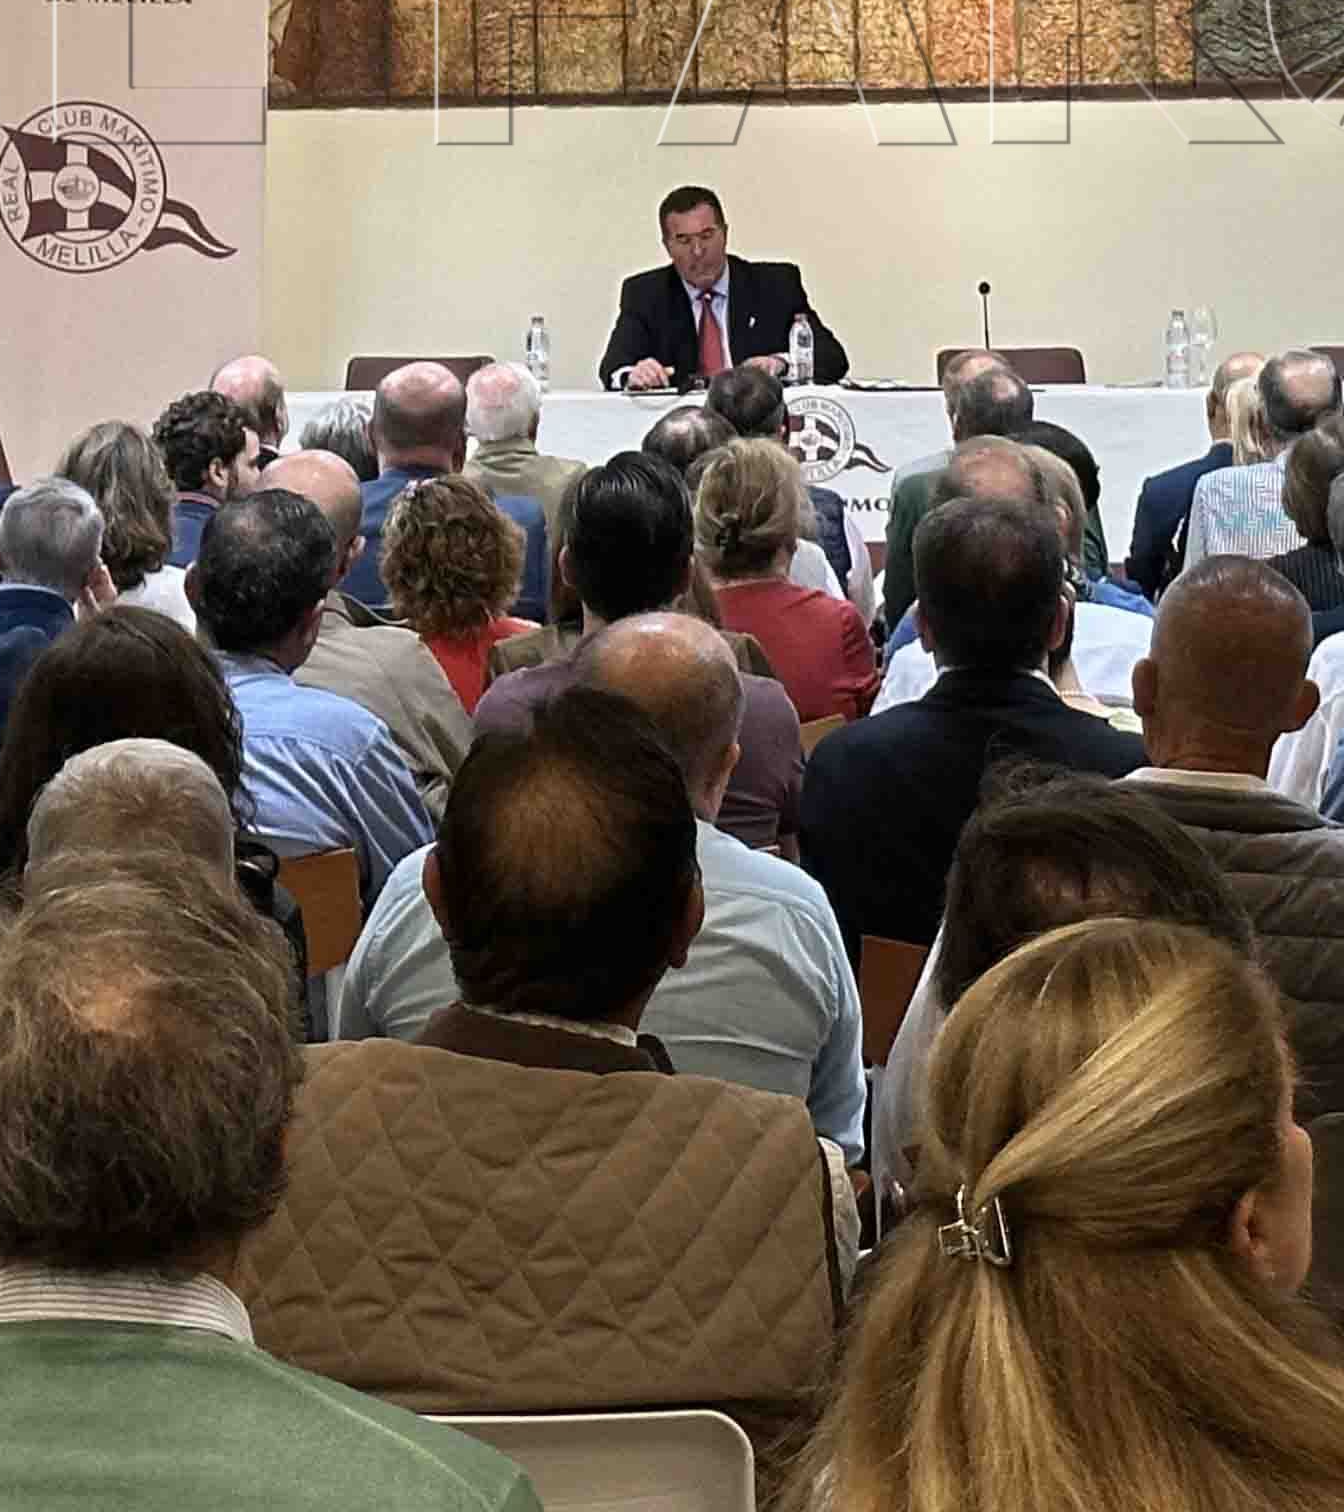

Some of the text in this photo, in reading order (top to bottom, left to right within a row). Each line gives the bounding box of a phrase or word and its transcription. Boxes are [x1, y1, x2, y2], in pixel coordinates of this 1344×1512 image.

[37, 110, 92, 135] CLUB
[2, 165, 23, 223] REAL
[35, 229, 138, 266] MELILLA
